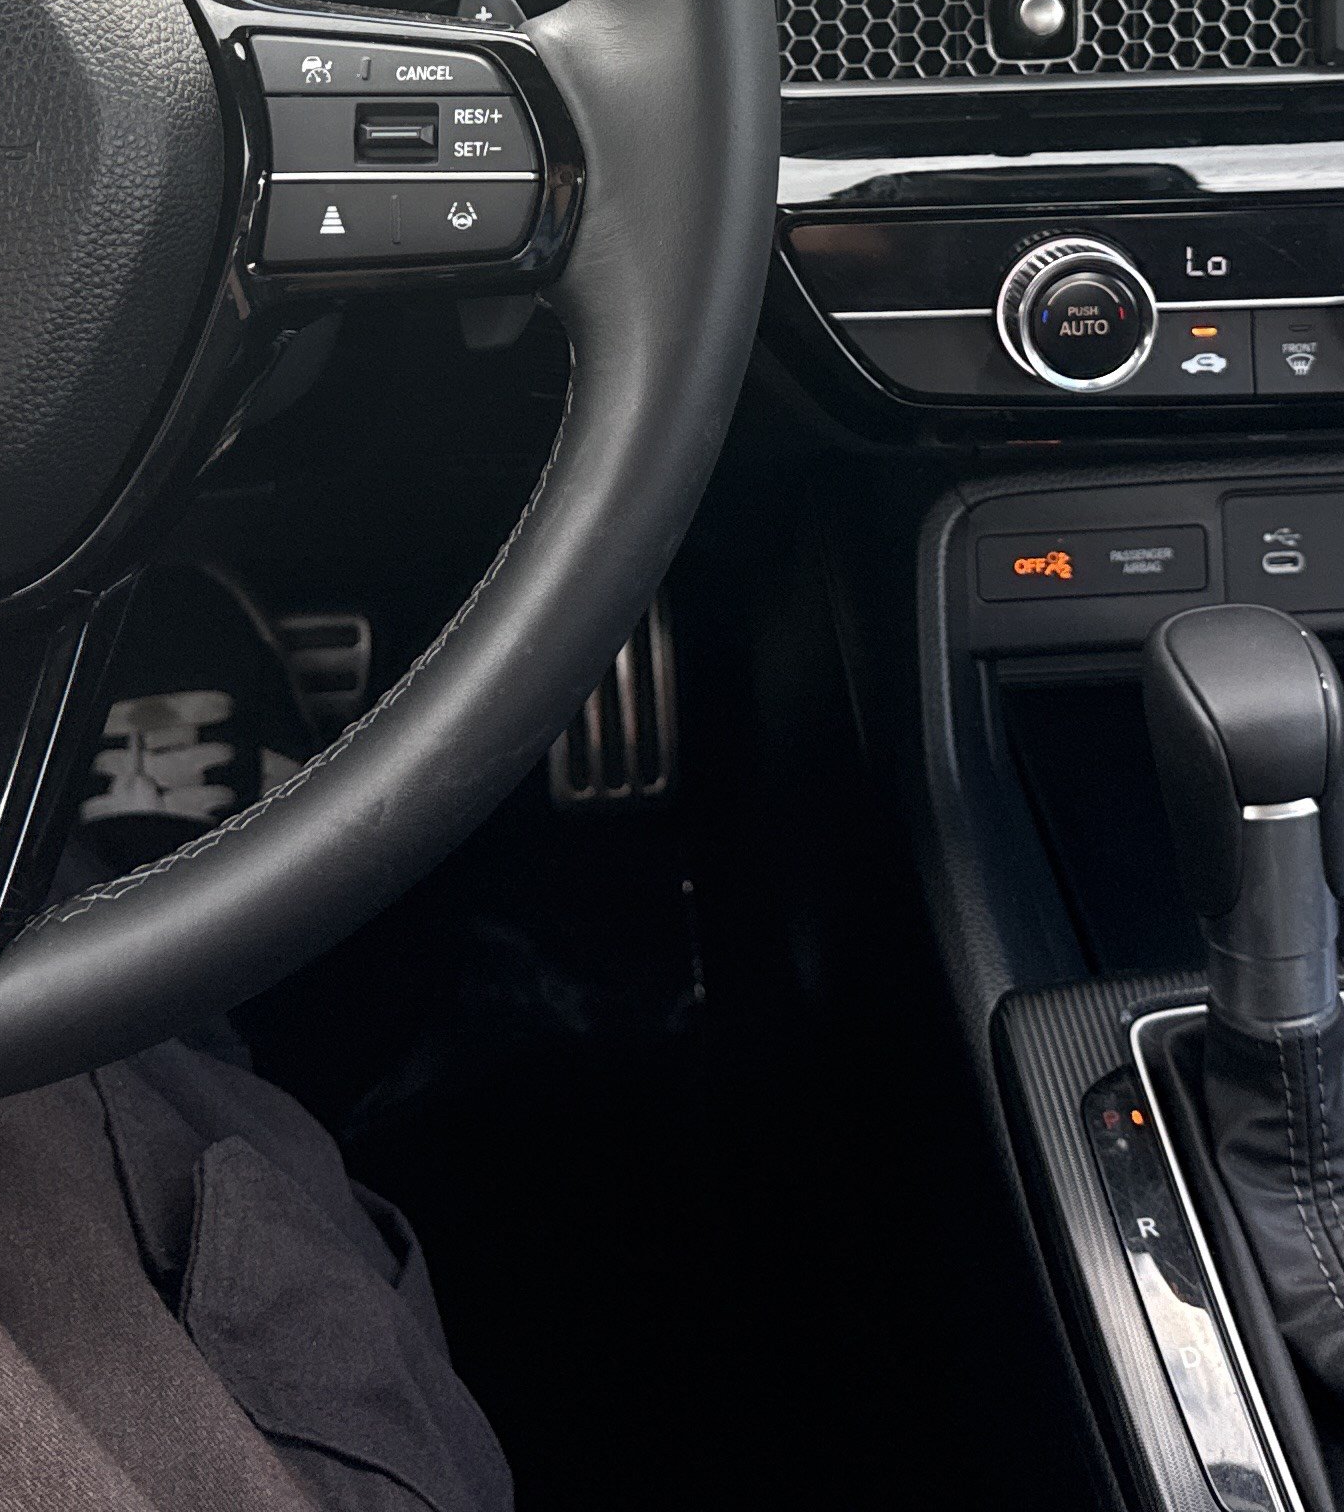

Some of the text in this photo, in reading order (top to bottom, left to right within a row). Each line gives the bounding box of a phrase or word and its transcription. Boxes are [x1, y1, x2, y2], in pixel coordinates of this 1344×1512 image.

[396, 65, 454, 81] CANCEL
[454, 109, 503, 124] RES/+
[1186, 246, 1227, 278] Lo
[1067, 306, 1099, 317] PUSH
[1059, 319, 1109, 336] AUTO
[1282, 342, 1317, 353] FRONT
[1014, 557, 1047, 575] OFF
[1136, 1217, 1160, 1239] R
[1179, 1347, 1202, 1370] D
